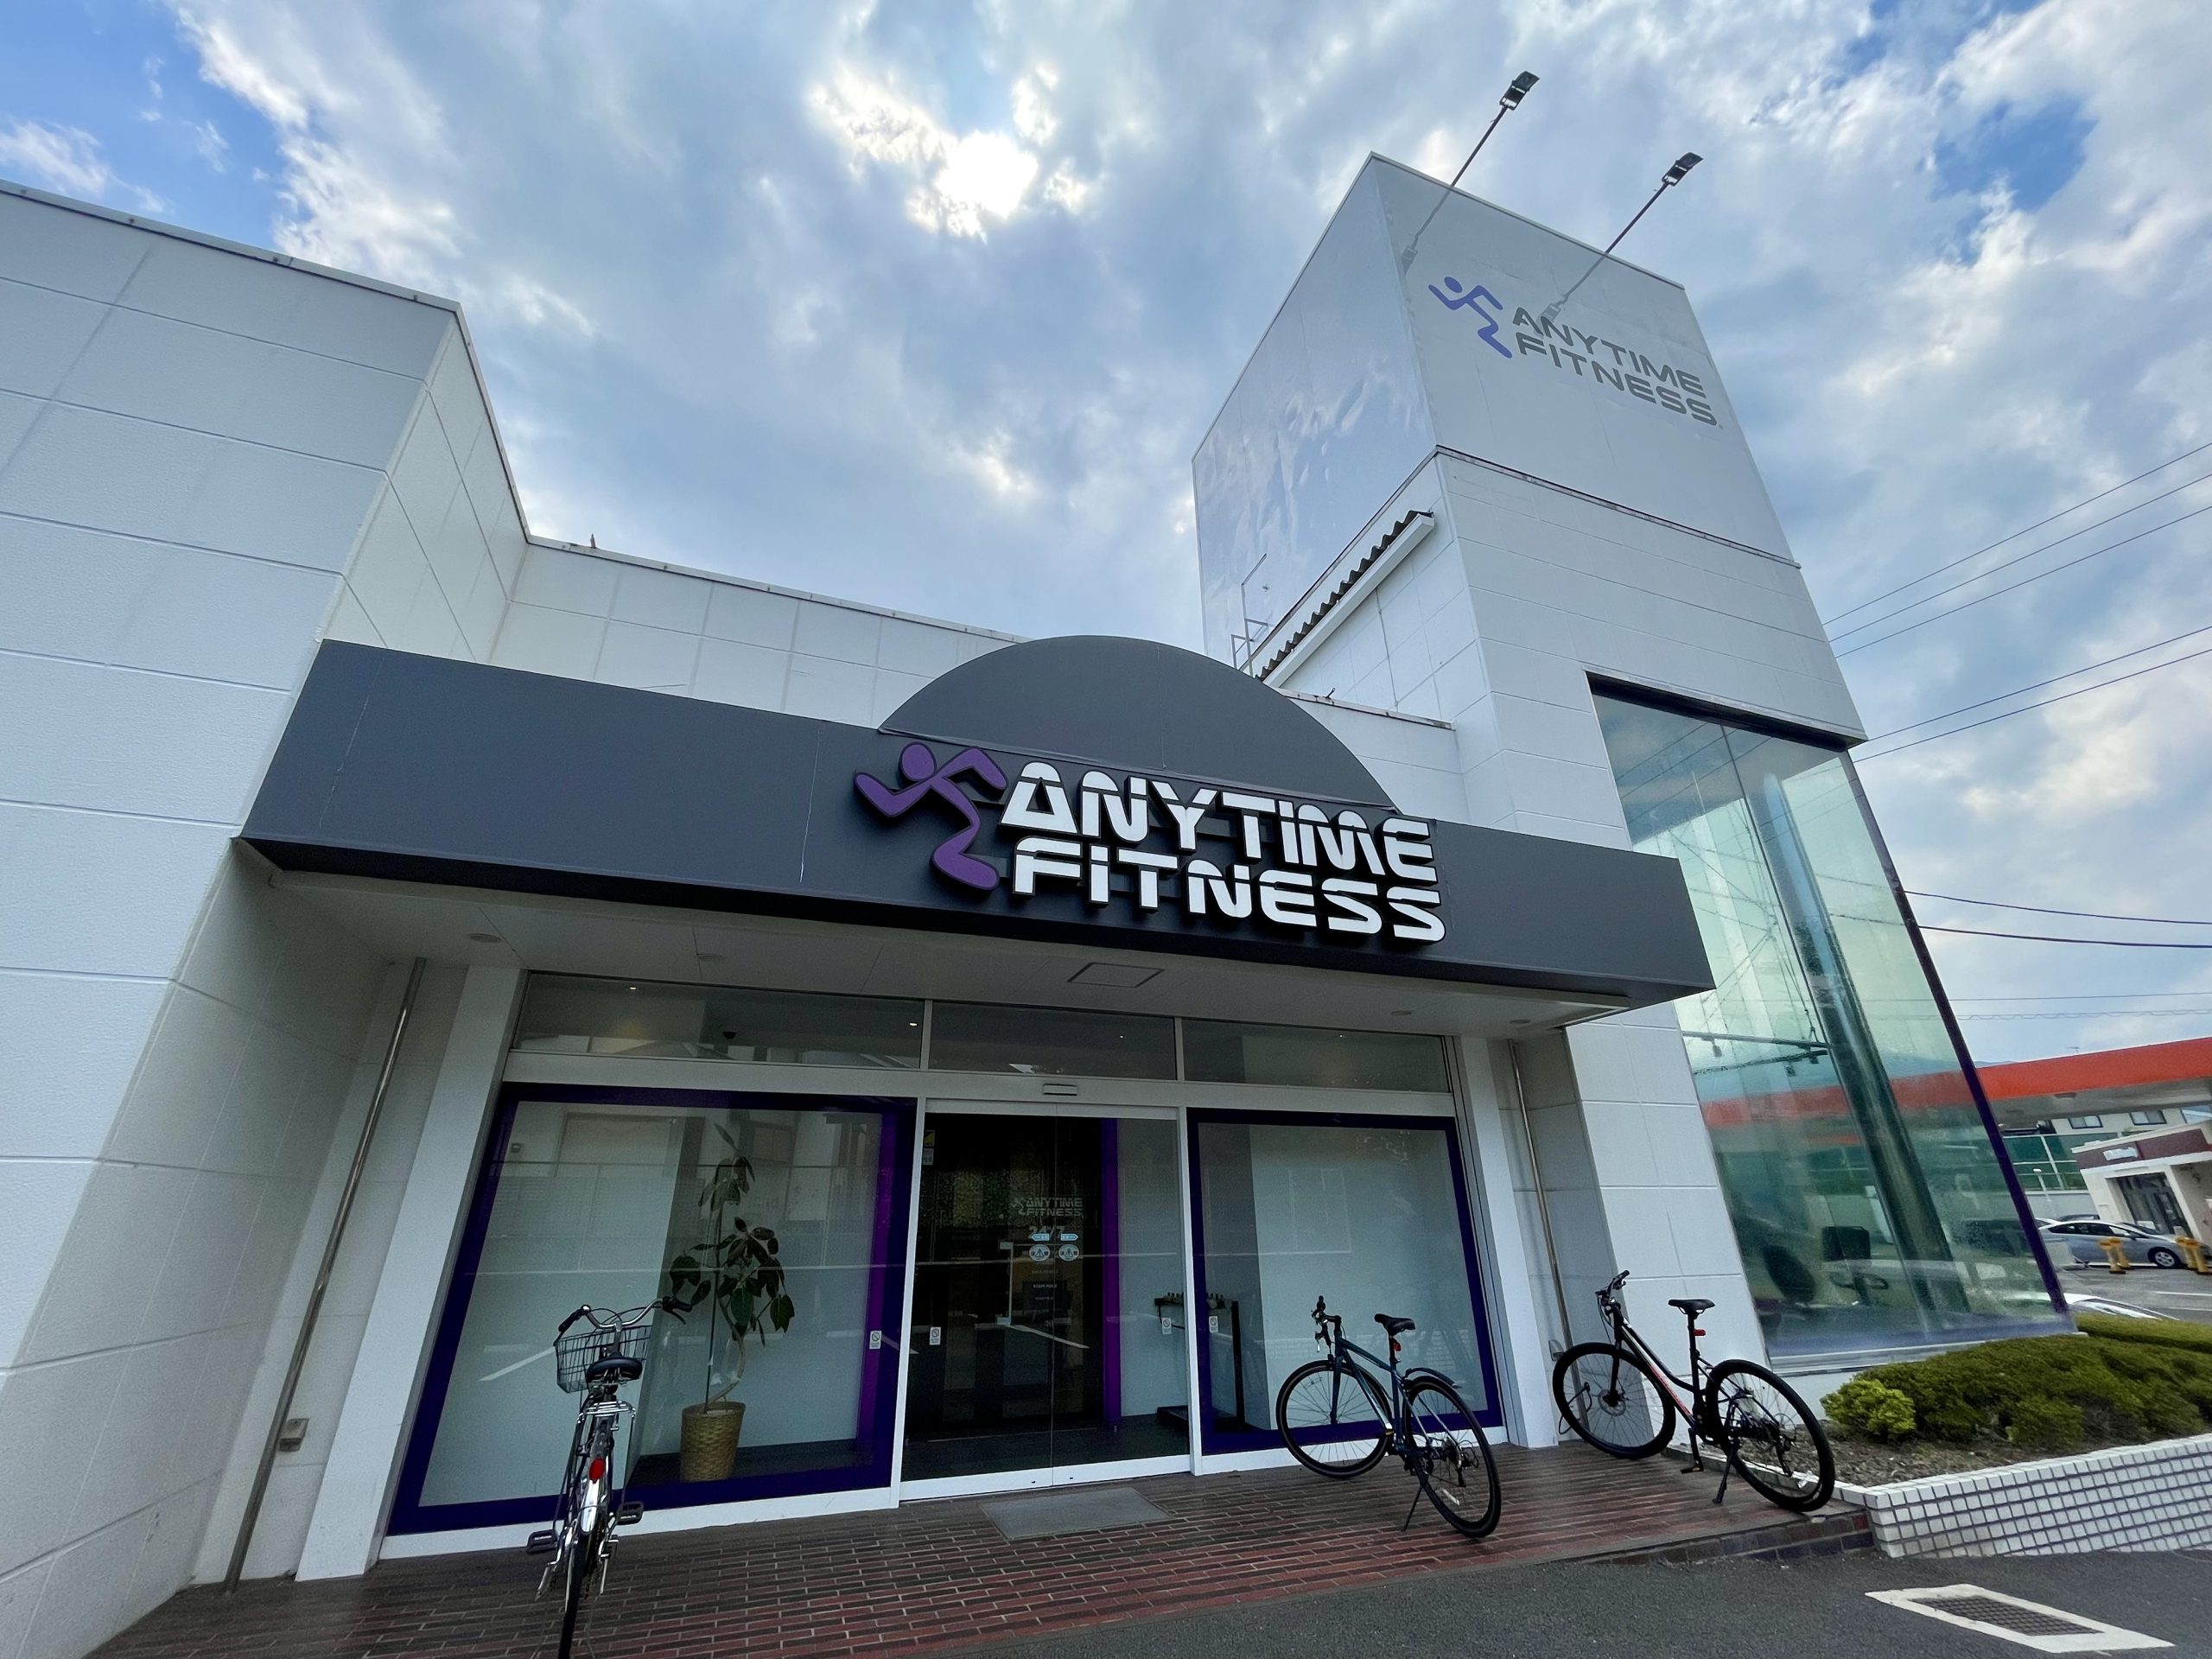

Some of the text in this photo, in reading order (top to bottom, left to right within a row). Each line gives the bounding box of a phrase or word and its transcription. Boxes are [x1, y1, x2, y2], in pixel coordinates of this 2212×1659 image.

[1512, 307, 1707, 398] ANYTIME
[1516, 333, 1718, 426] FITNESS
[1000, 762, 1439, 883] ANYTIME
[1013, 837, 1446, 943] FITNESS
[1026, 1197, 1084, 1208] ANYTIME
[1026, 1208, 1084, 1217] FITNESS
